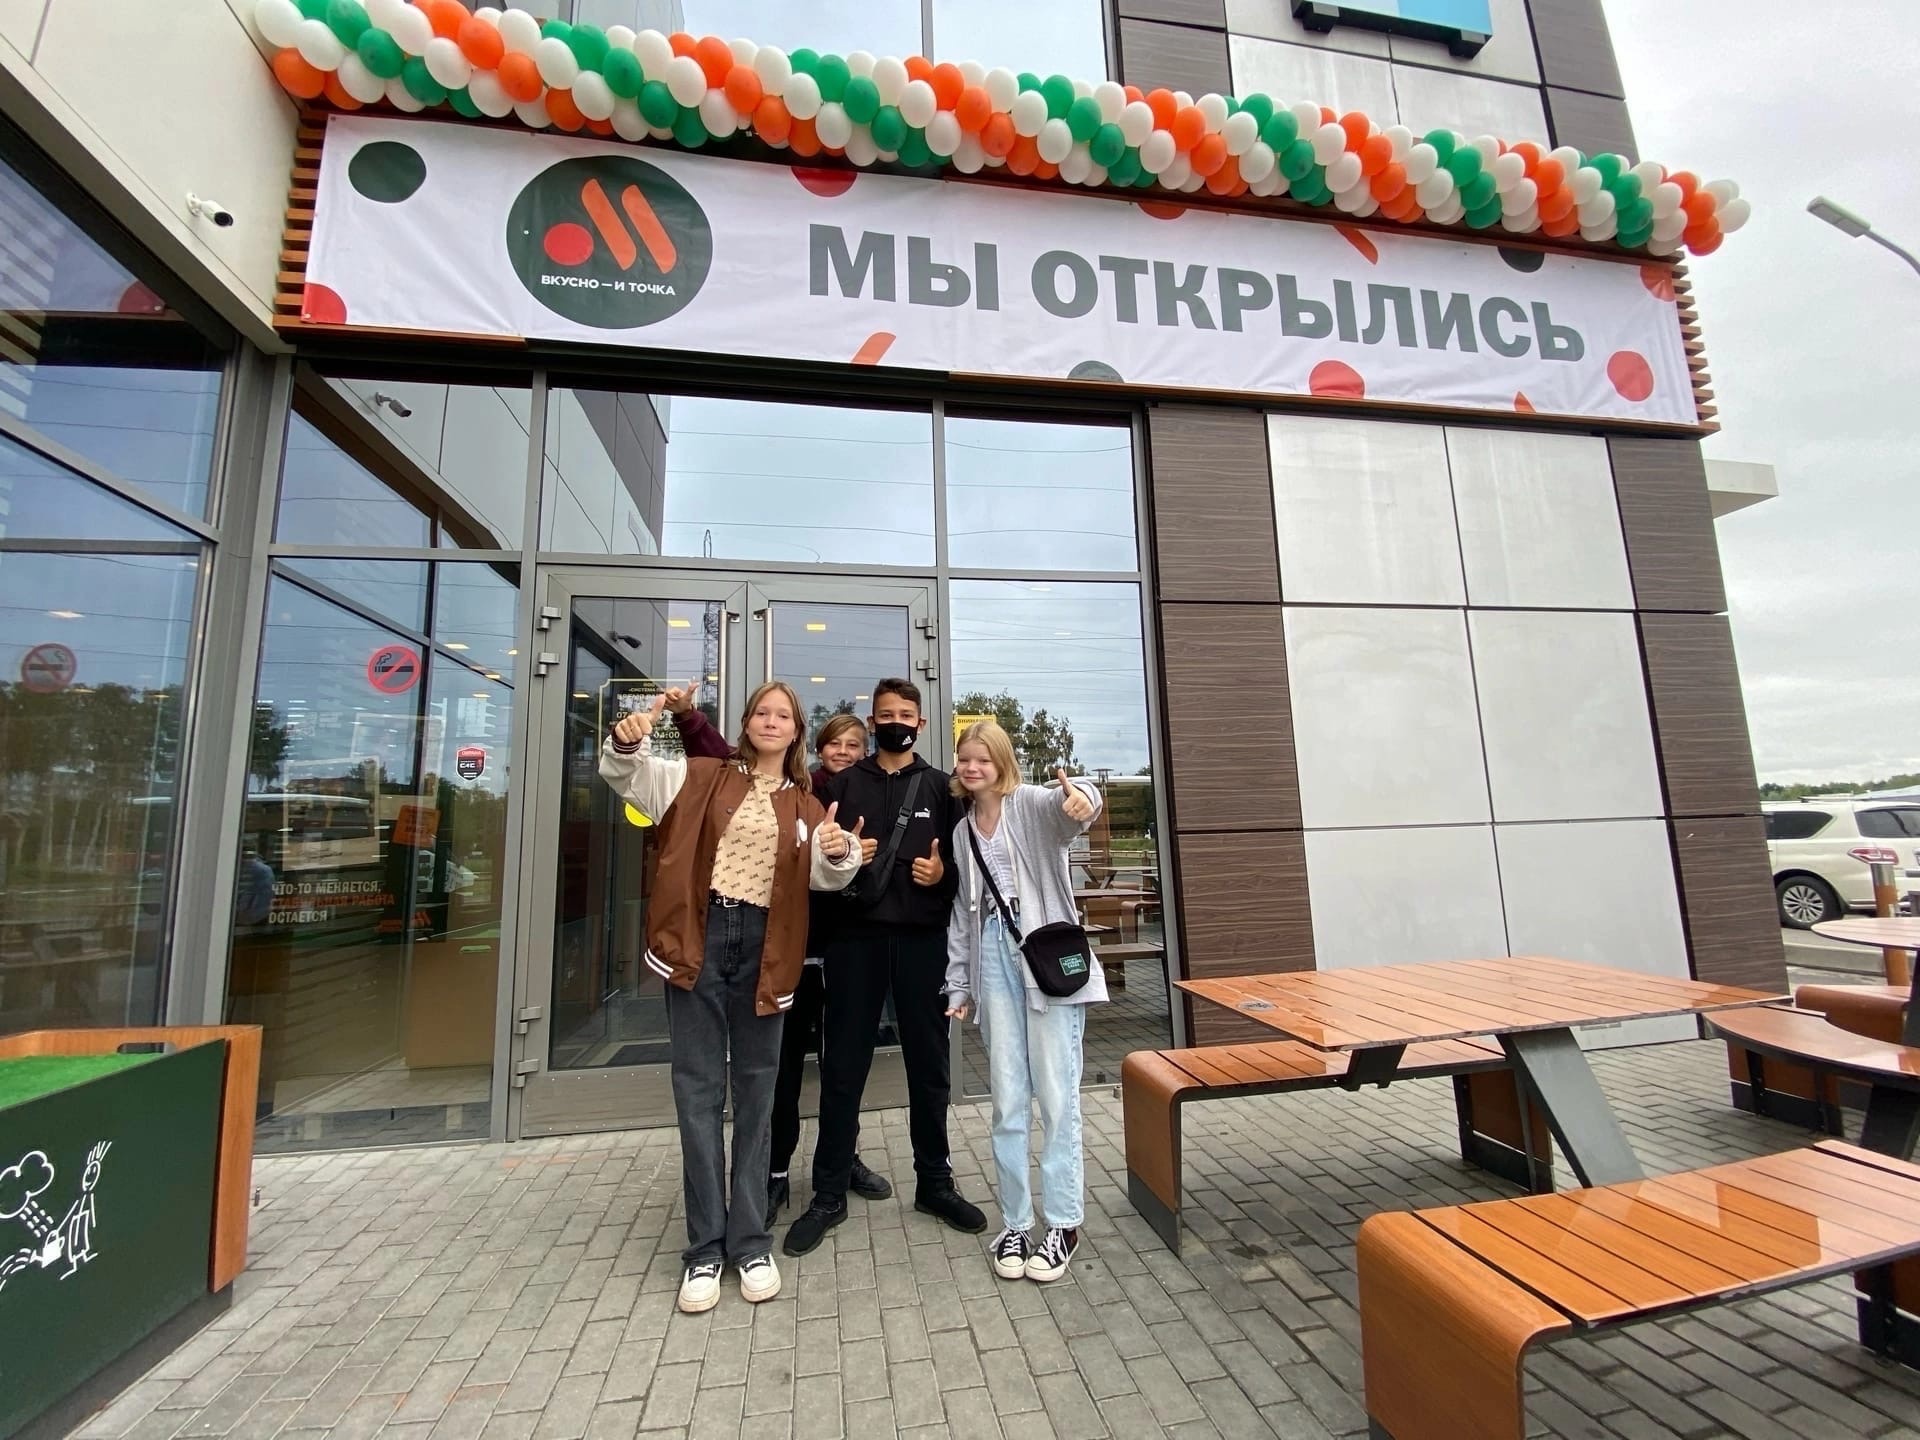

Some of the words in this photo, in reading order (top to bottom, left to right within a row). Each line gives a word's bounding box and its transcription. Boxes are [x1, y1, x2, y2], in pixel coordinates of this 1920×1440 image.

[541, 274, 599, 289] ВКУСНО
[614, 281, 625, 291] И
[628, 282, 676, 296] ТОЧКА
[809, 223, 1000, 312] МЫ
[1031, 249, 1585, 362] ОТКРЫЛИСЬ
[271, 882, 312, 895] ЧТО-ТО
[268, 910, 328, 924] ОСТАЕТСЯ
